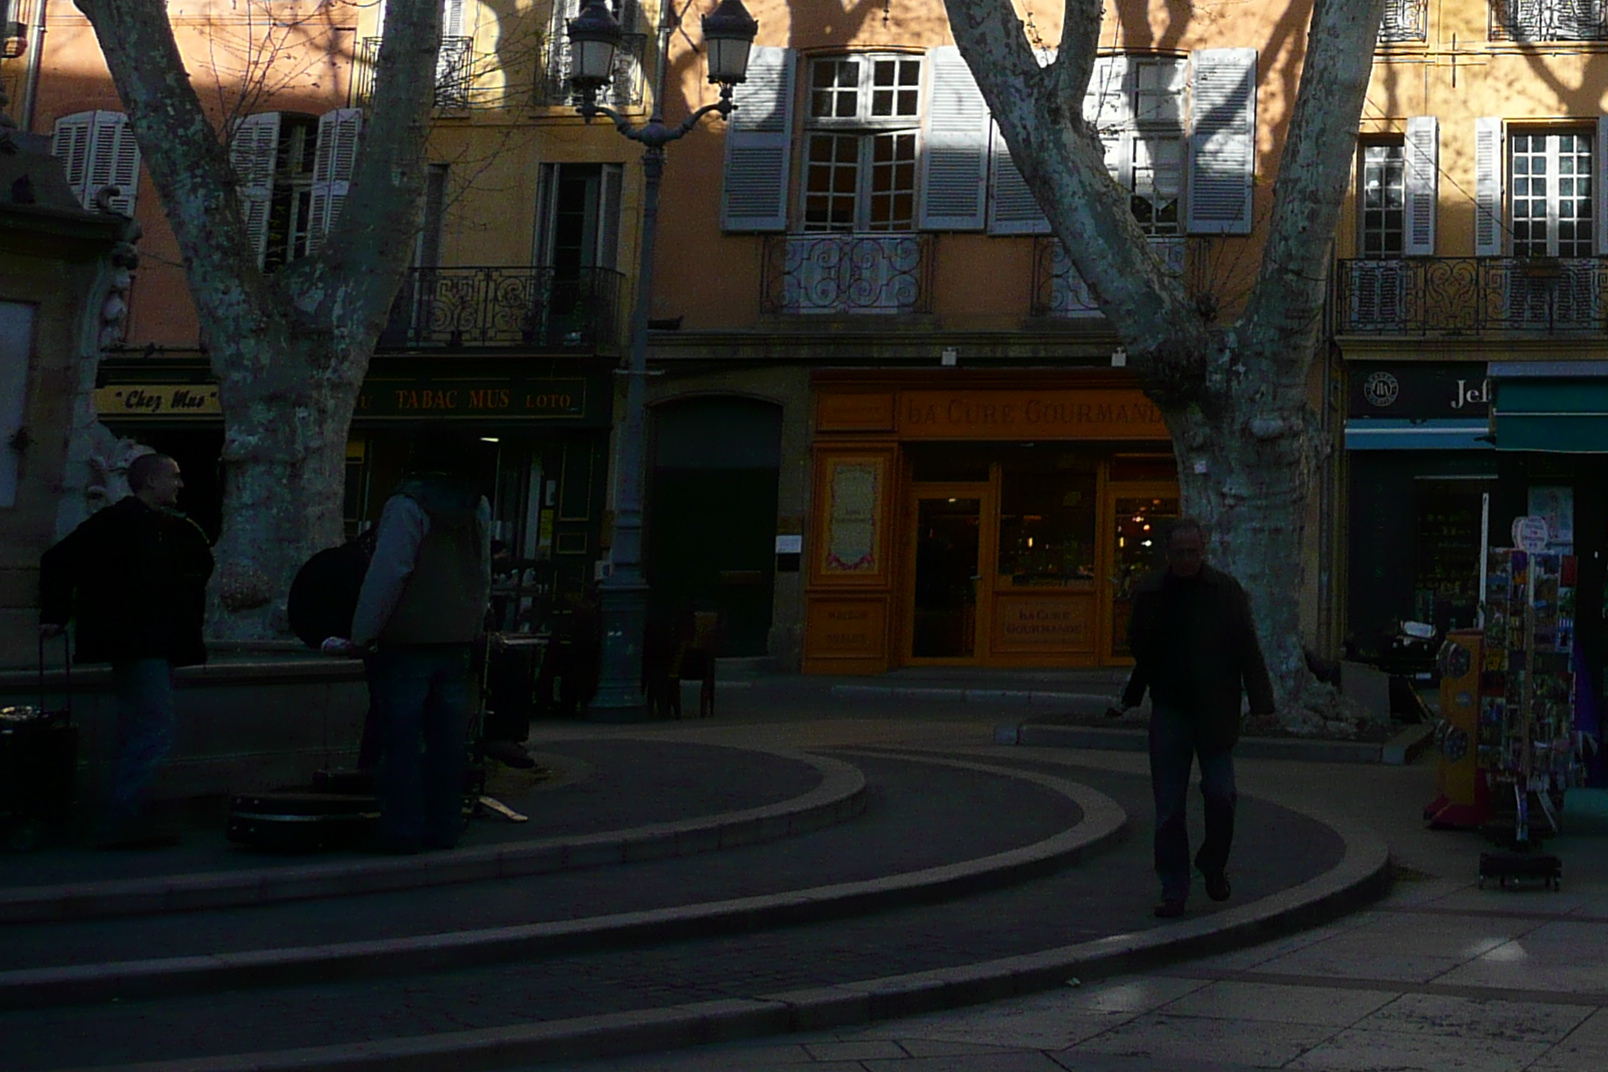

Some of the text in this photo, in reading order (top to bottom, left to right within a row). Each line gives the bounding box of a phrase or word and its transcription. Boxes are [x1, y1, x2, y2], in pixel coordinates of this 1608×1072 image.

[395, 388, 459, 410] TABAC
[468, 388, 511, 409] MUS
[525, 393, 573, 409] LOTO
